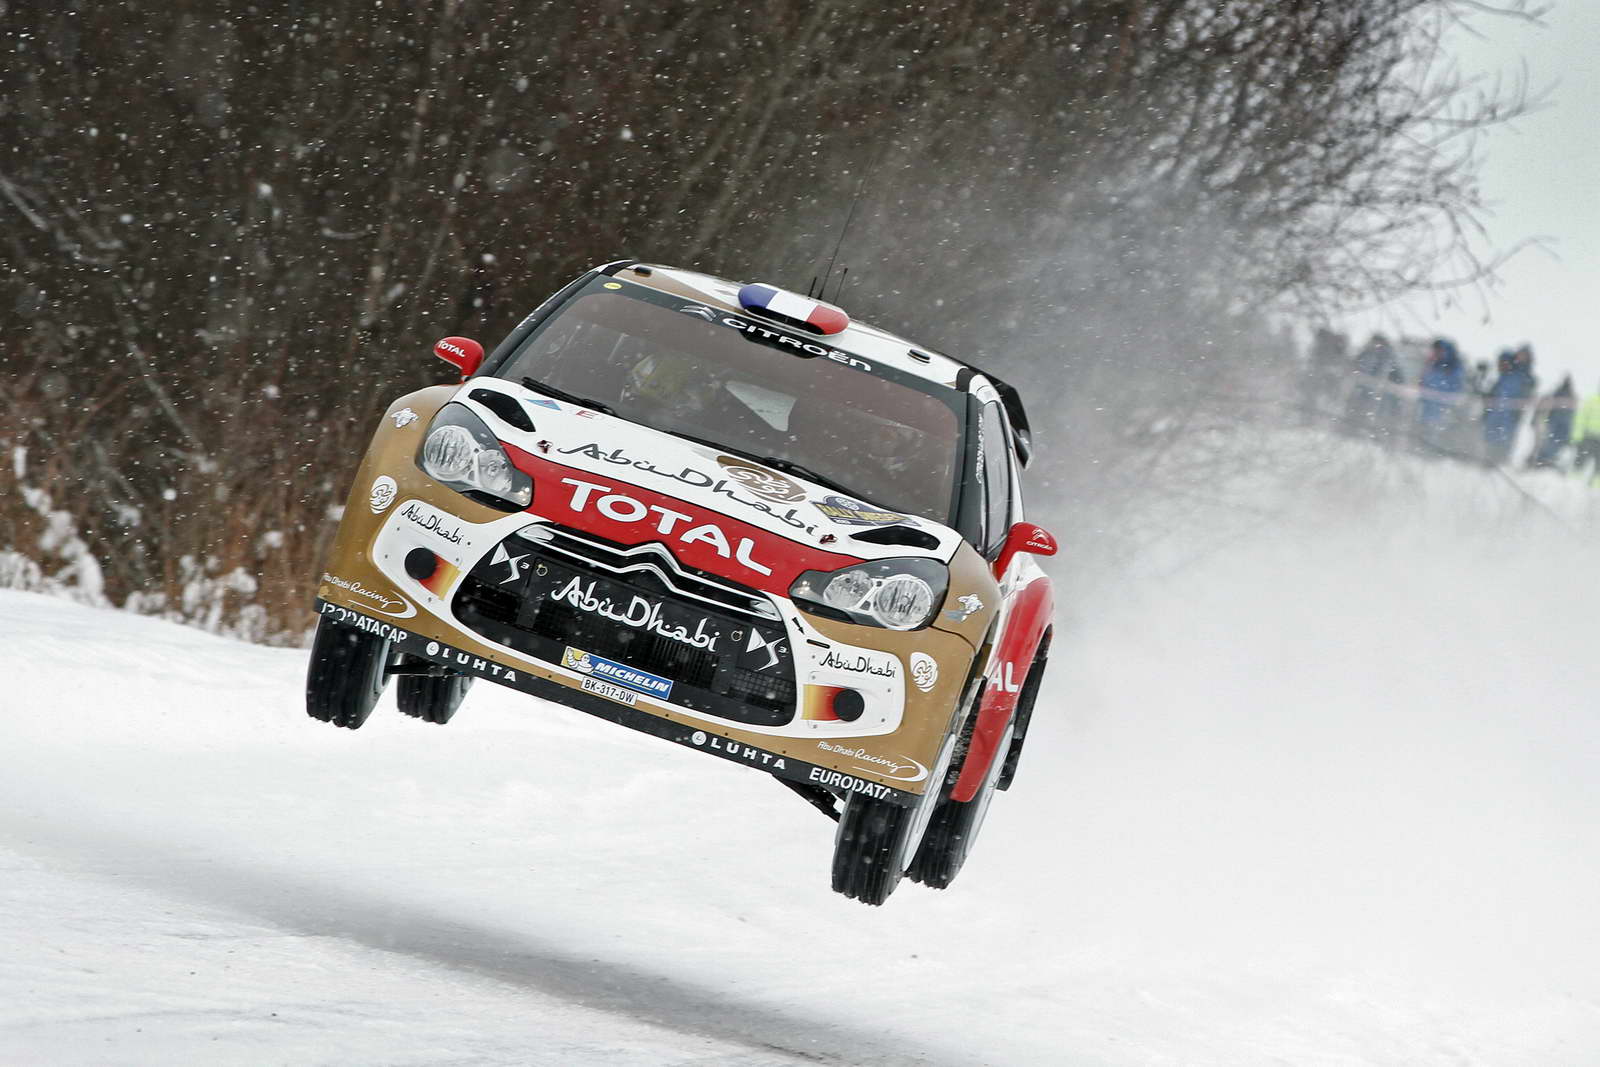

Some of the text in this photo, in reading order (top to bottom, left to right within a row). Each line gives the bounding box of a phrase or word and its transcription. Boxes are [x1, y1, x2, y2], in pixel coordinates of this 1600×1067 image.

[438, 340, 466, 358] TOTAL
[560, 477, 773, 577] TOTAL
[349, 582, 404, 609] Racing
[442, 647, 517, 682] LUHTA
[594, 662, 670, 693] MICHELIN
[583, 679, 635, 703] BK-317-DW
[710, 737, 786, 770] LUHTA
[854, 748, 917, 774] Racing
